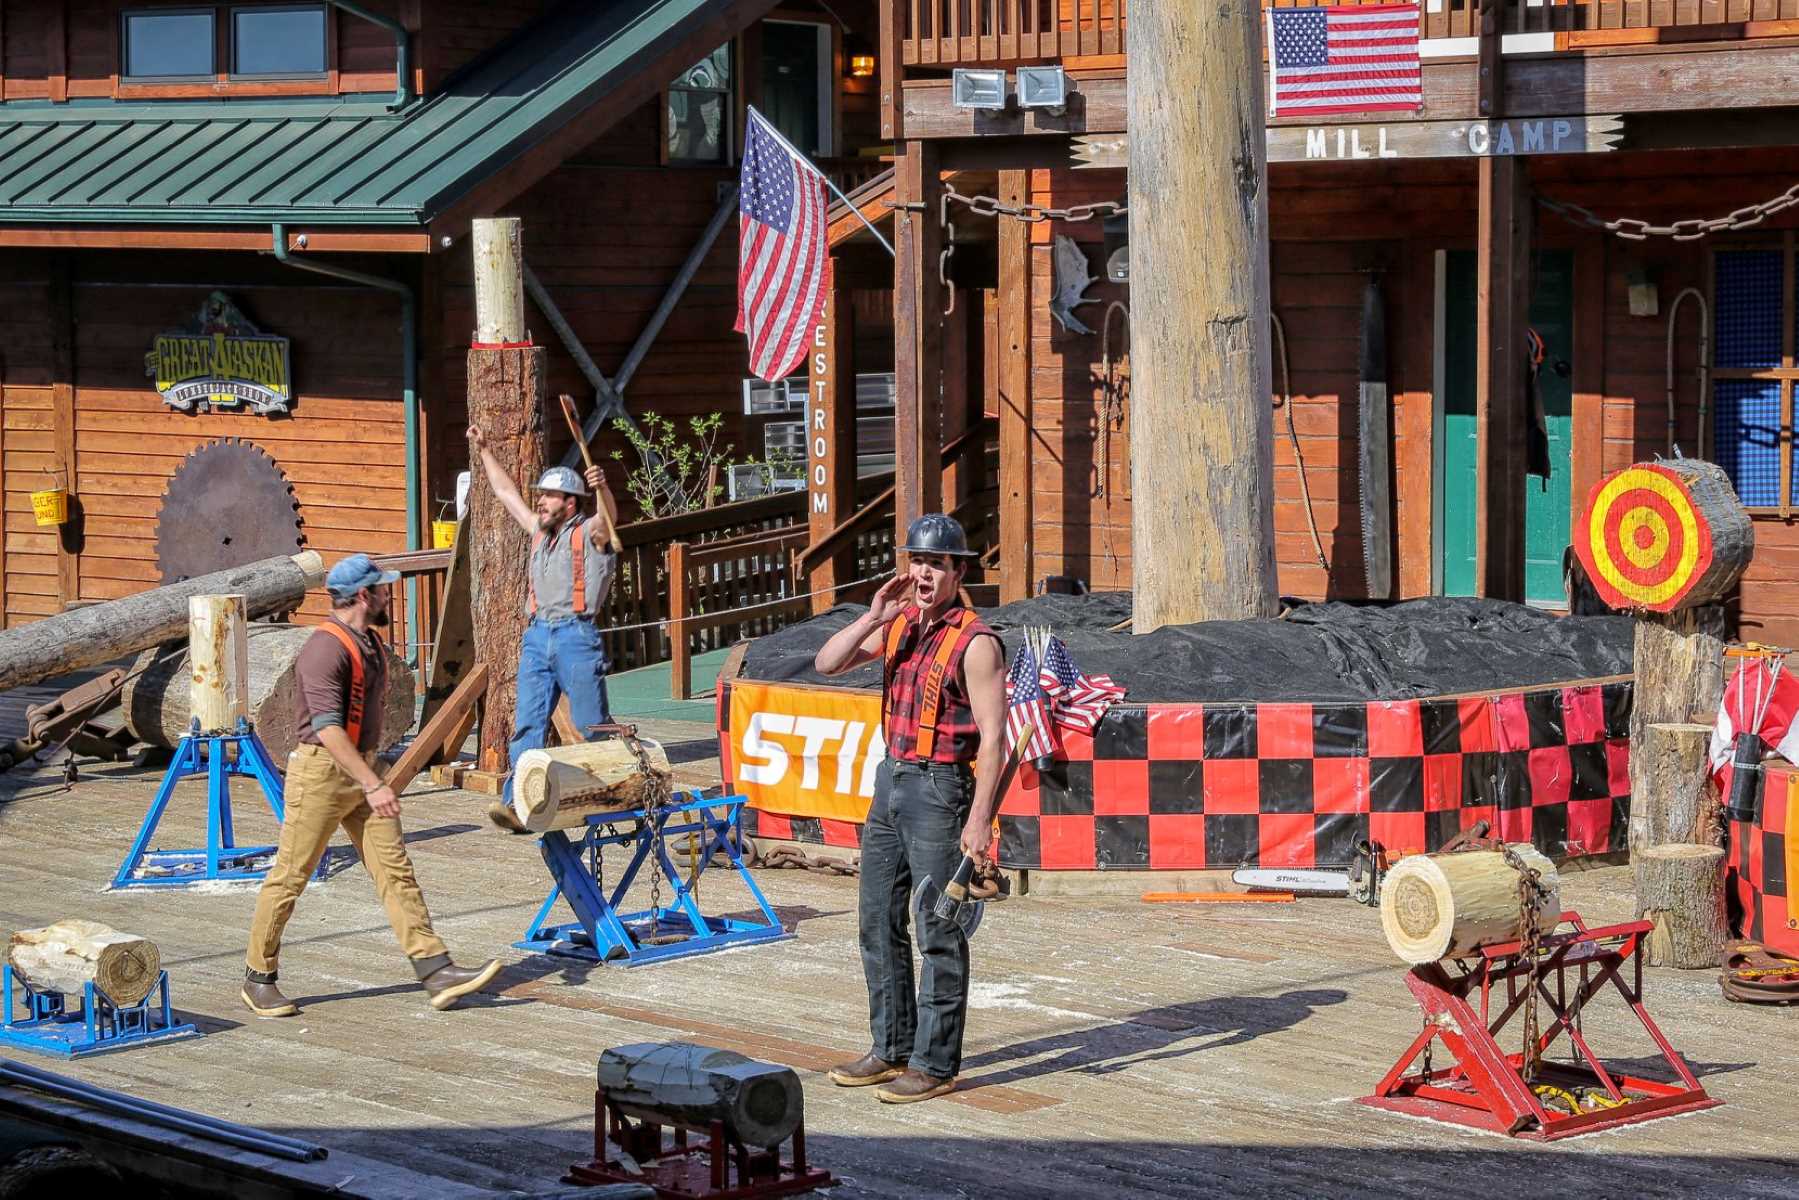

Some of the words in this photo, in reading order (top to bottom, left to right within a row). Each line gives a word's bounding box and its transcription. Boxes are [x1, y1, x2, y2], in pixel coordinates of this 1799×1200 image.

[1306, 127, 1397, 159] MILL
[1468, 121, 1571, 154] CAMP
[157, 337, 210, 391] GREAT
[210, 332, 287, 399] ALASKAN
[923, 660, 944, 717] STIHL
[1276, 875, 1299, 883] STIHL
